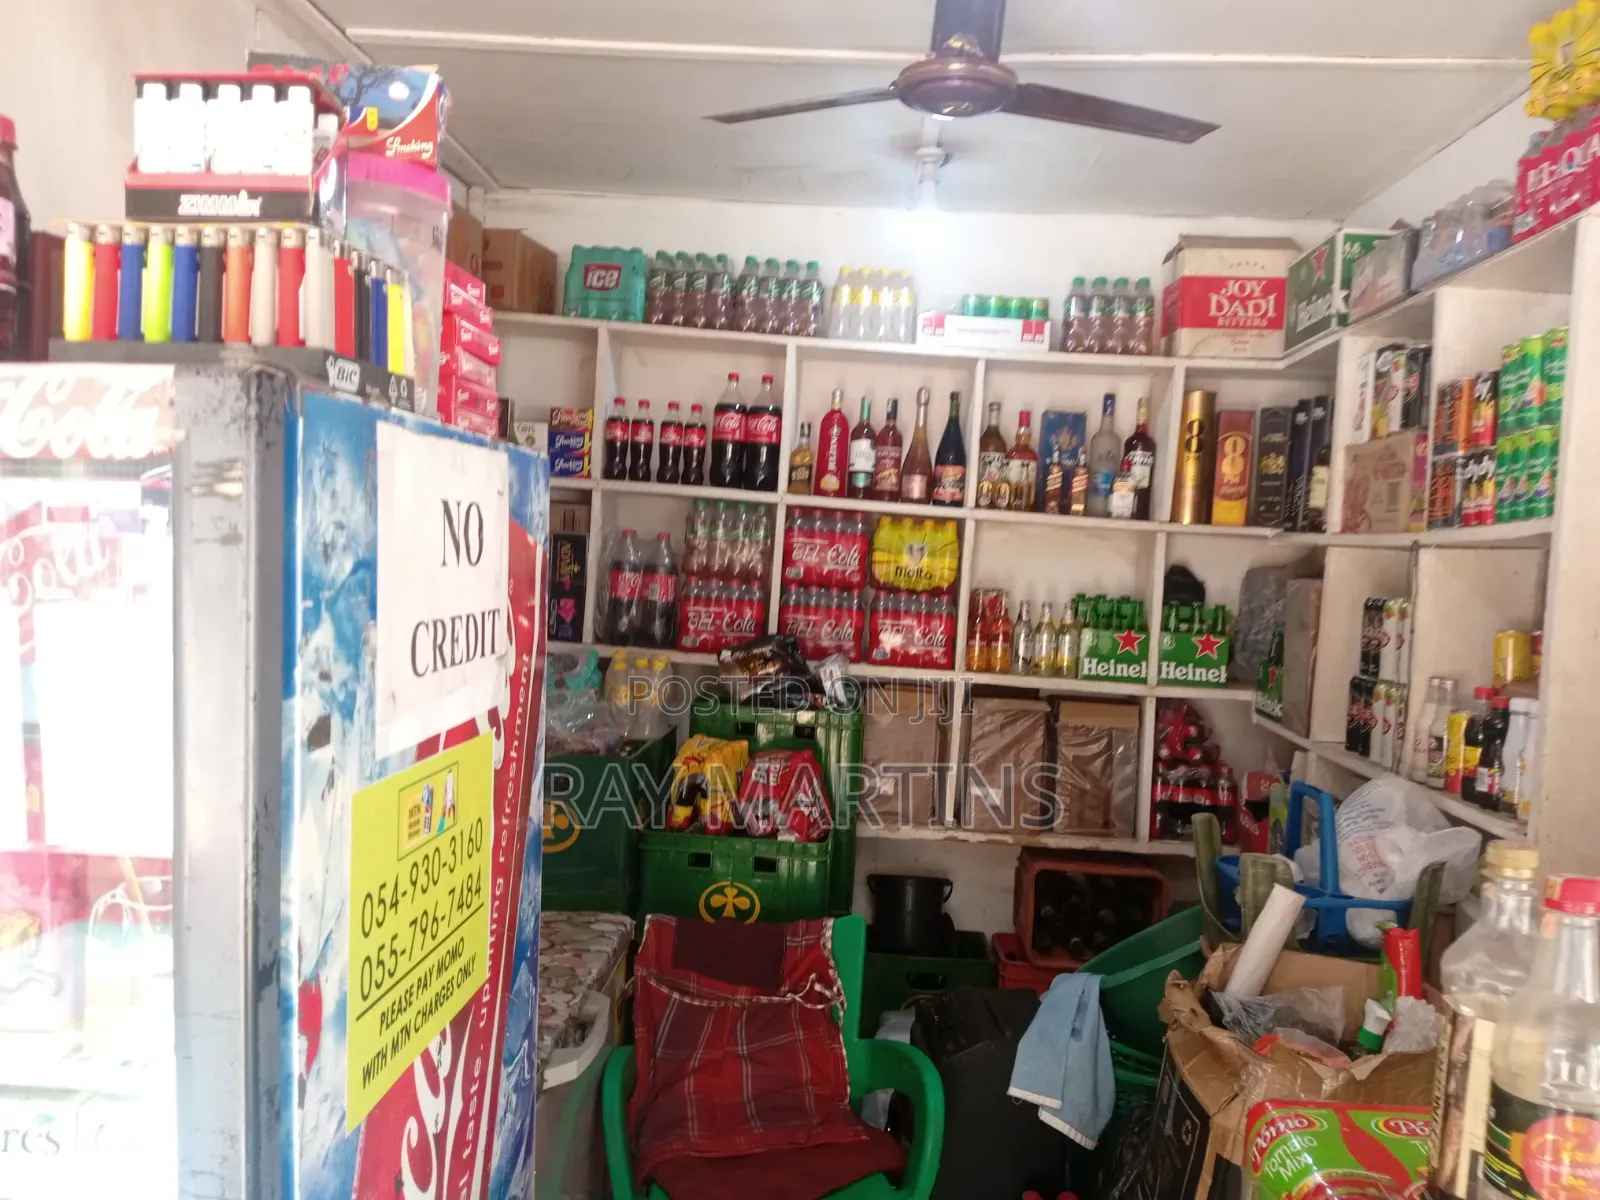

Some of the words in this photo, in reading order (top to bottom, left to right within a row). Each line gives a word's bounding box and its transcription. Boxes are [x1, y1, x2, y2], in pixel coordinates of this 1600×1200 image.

[385, 136, 434, 158] Smoking
[1208, 292, 1278, 318] DADI
[1221, 279, 1268, 297] JOY
[1216, 316, 1269, 328] BITTERS
[1221, 435, 1247, 475] 8
[440, 499, 484, 568] NO
[791, 541, 861, 568] BEL-Cola
[687, 610, 756, 633] BEL-Cola
[410, 608, 501, 679] CREDIT
[361, 816, 483, 939] 054-930-3160
[360, 865, 482, 1002] 055-796-7484
[379, 983, 415, 1037] PLEASE
[416, 964, 435, 1000] PAY
[436, 936, 465, 980] MOMO
[362, 1043, 389, 1091] WITH
[390, 1018, 412, 1061] MTN
[413, 976, 455, 1034] CHARGES
[456, 952, 477, 990] ONLY
[1264, 1135, 1318, 1180] Tomato
[1278, 1152, 1312, 1183] Mix
